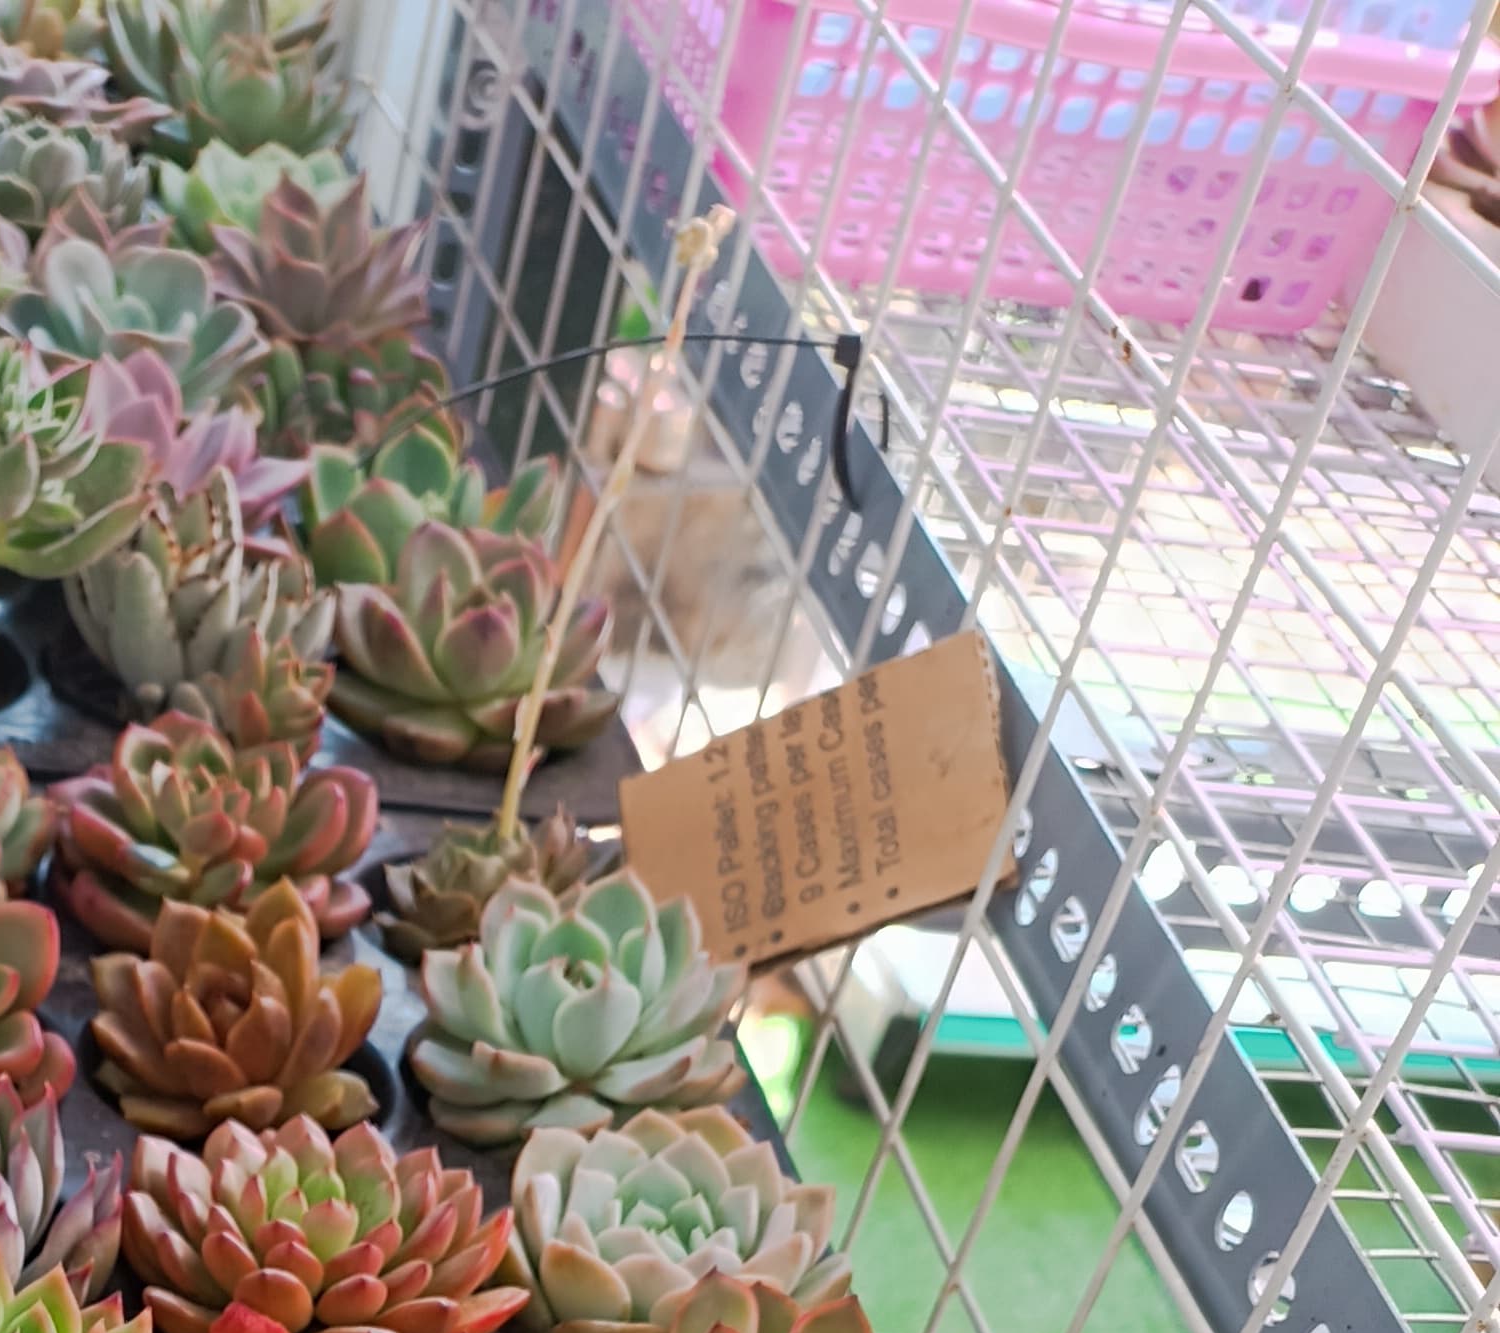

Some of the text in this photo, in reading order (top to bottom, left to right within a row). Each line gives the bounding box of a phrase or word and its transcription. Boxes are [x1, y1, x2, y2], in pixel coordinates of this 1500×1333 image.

[863, 720, 891, 801] cases
[794, 792, 822, 879] Cases
[827, 755, 863, 890] Maximum
[869, 805, 902, 876] Total
